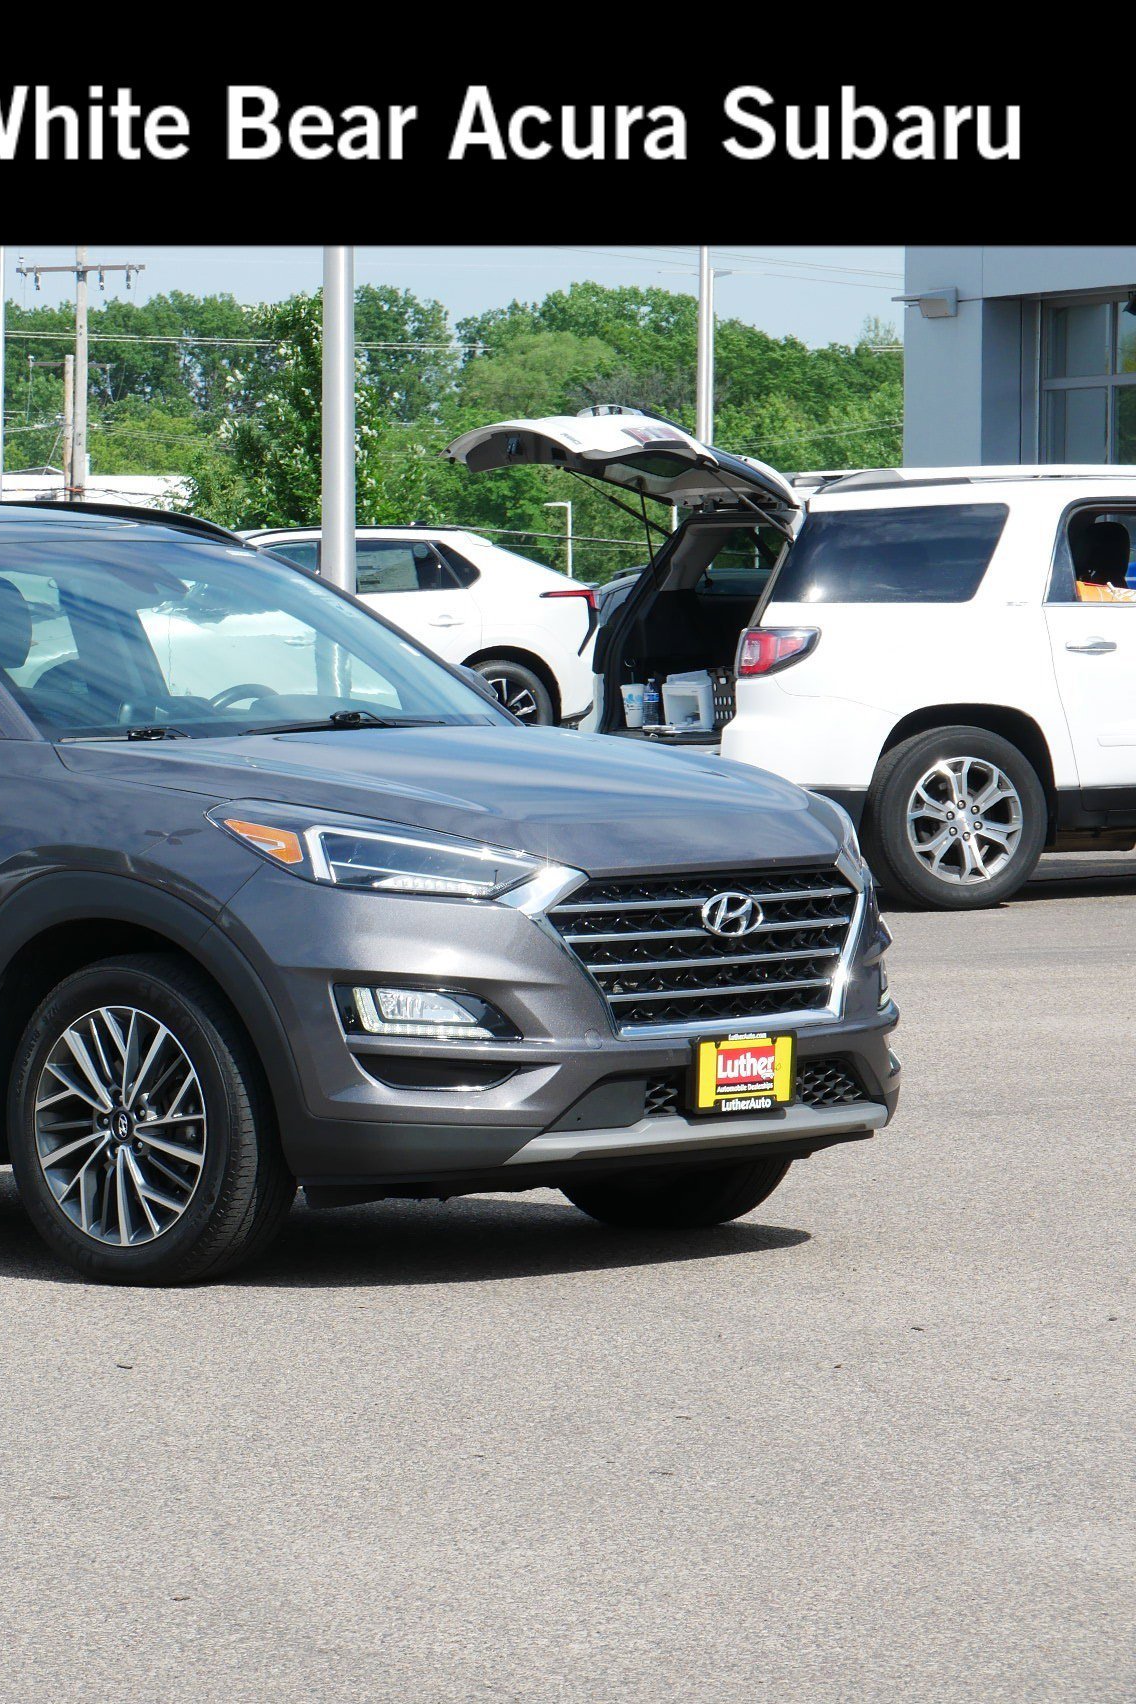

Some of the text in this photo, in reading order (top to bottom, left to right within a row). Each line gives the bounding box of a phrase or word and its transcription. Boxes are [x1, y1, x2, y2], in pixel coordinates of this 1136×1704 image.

[717, 1052, 775, 1078] Luther
[716, 1082, 773, 1093] Automobile Dealerships
[721, 1097, 772, 1111] LutherAuto
